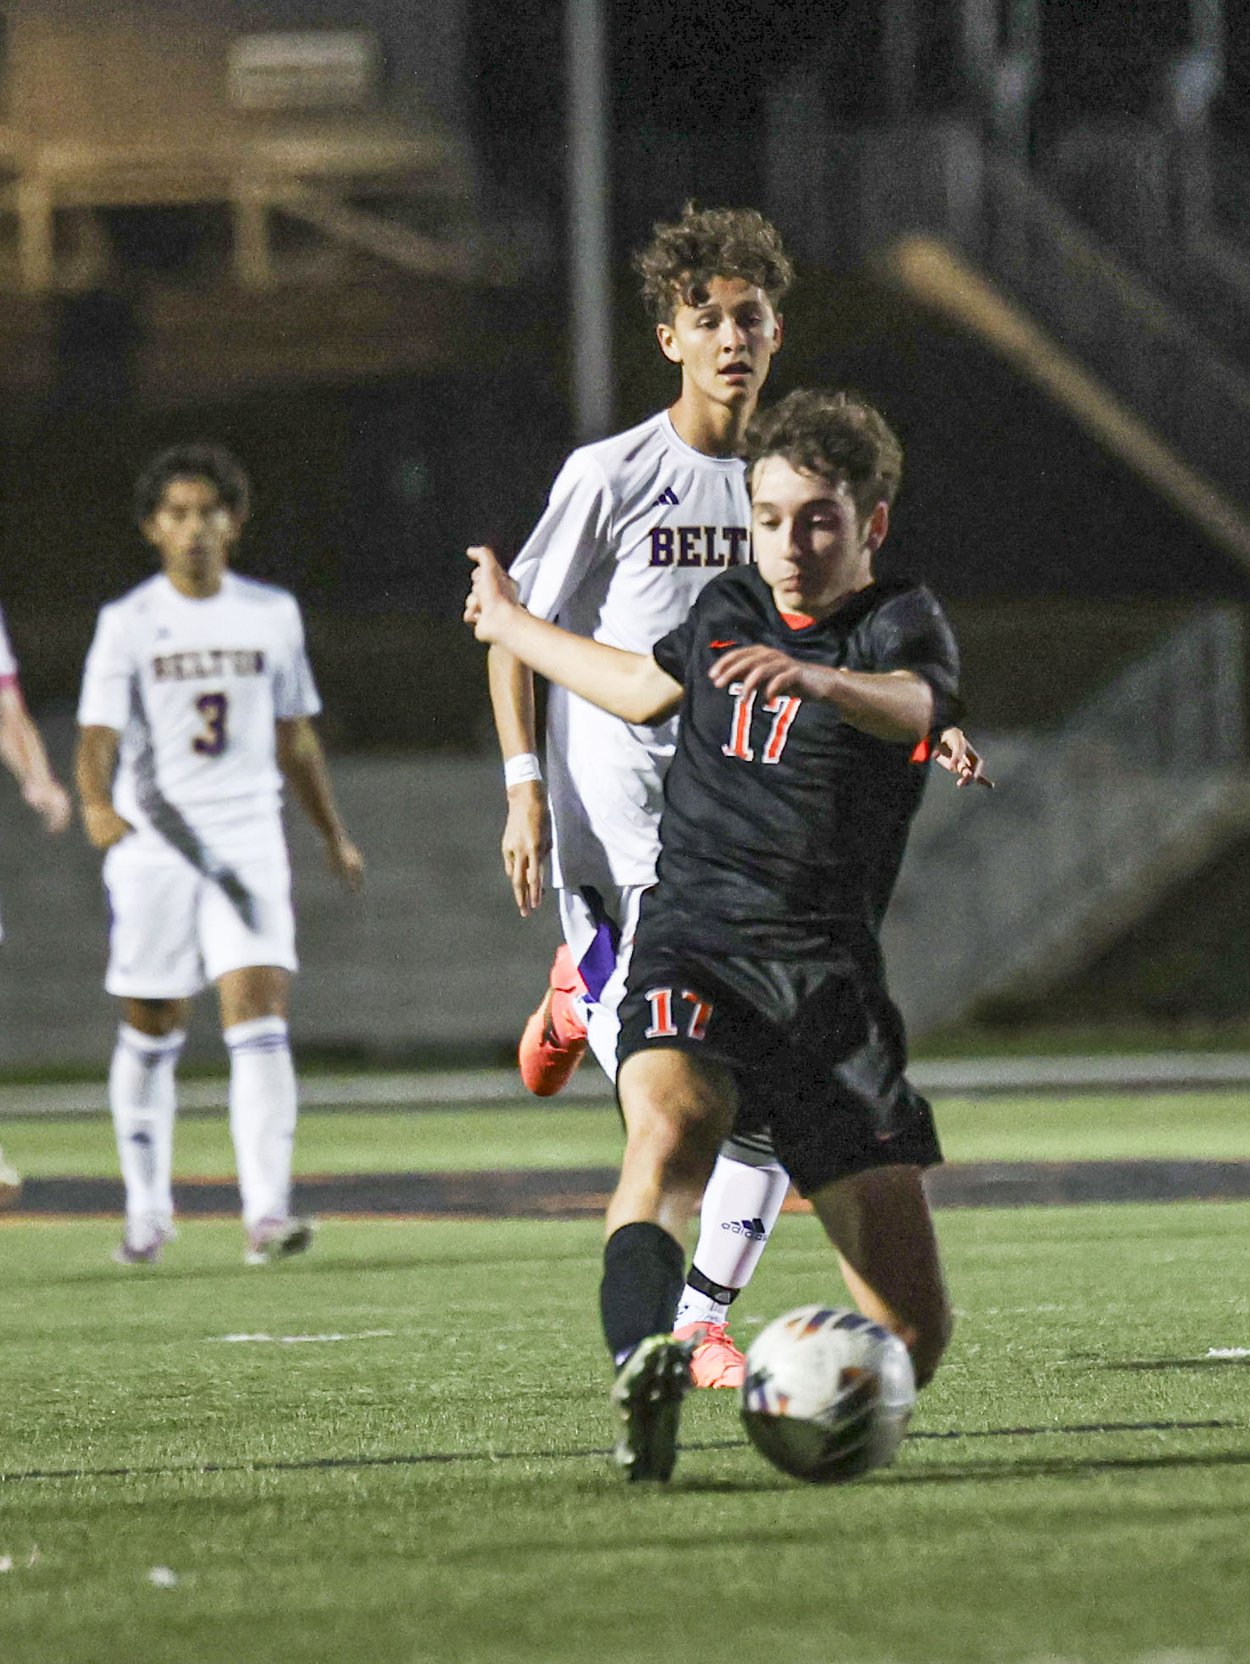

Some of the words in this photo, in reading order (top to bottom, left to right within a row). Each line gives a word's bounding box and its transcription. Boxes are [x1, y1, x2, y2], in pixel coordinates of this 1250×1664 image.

[649, 526, 760, 569] BELT
[193, 692, 228, 756] 3
[721, 681, 802, 765] 17
[644, 988, 713, 1040] 17
